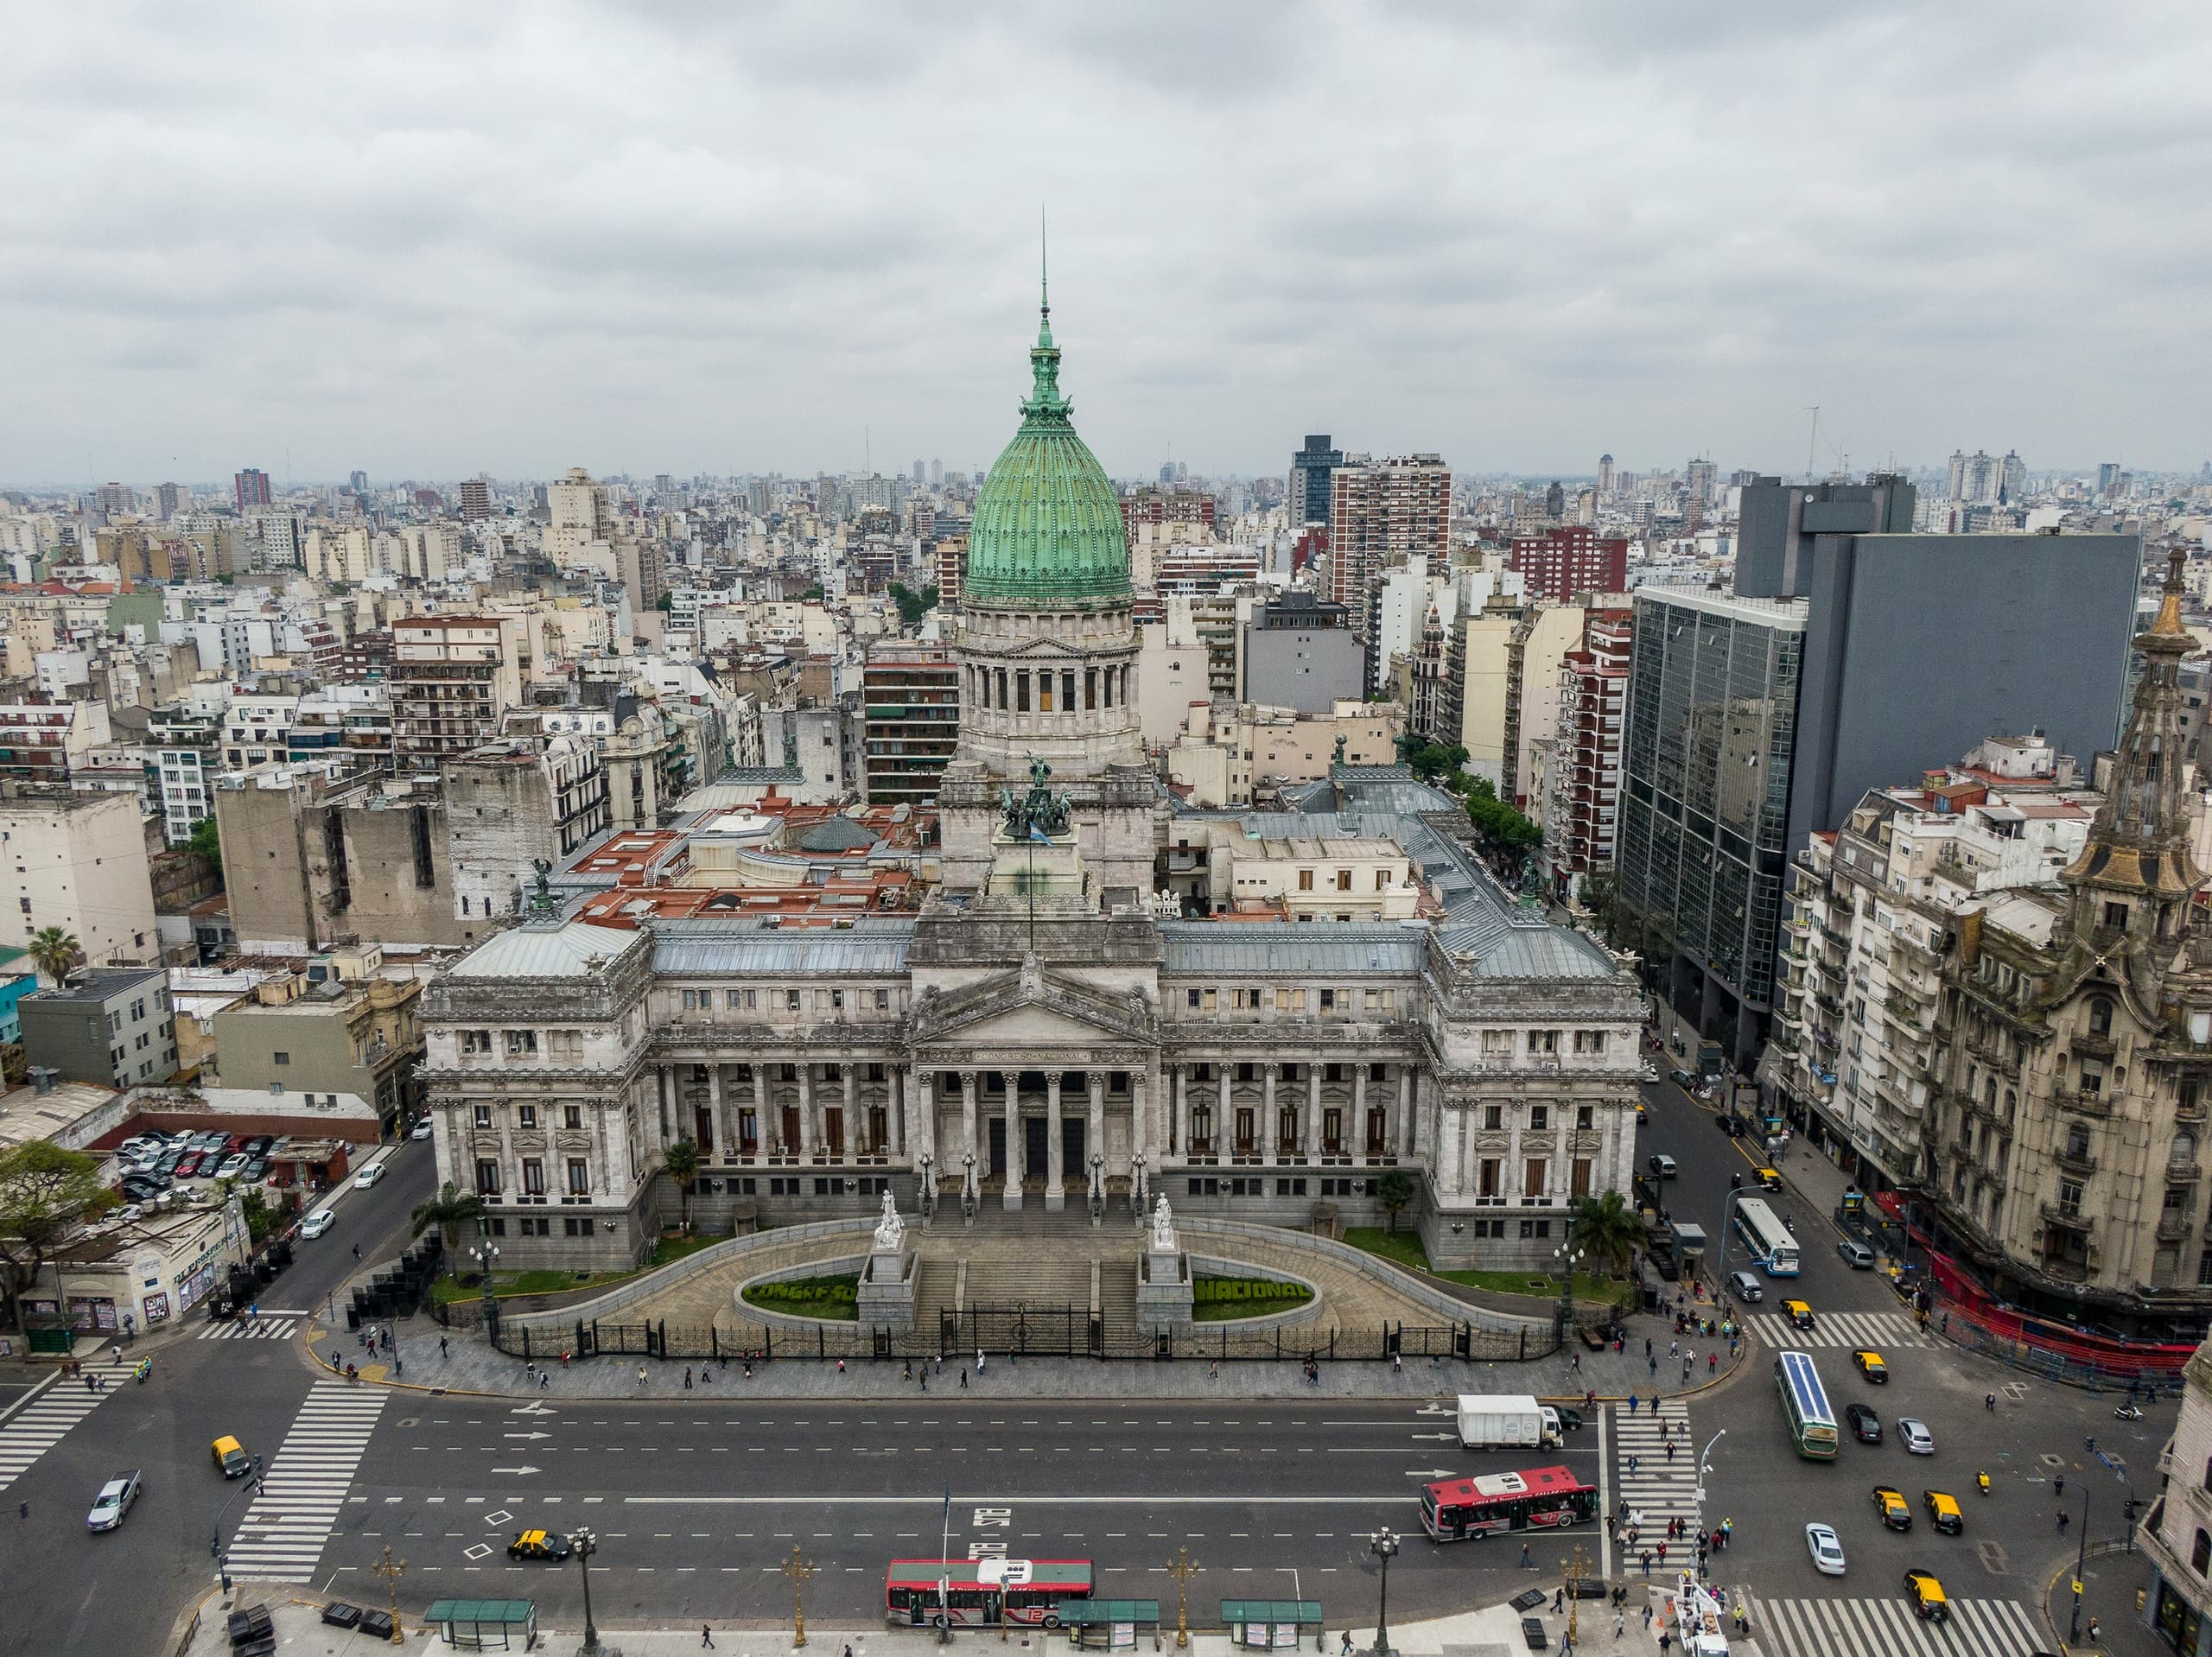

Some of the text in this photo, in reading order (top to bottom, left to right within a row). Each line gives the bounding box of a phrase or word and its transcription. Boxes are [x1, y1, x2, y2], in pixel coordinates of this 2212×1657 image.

[1037, 1052, 1081, 1061] NACIONAL
[1194, 1279, 1312, 1299] NACIONAL
[973, 1508, 1011, 1526] BUS
[968, 1543, 1007, 1560] BUS
[1028, 1611, 1043, 1621] 12
